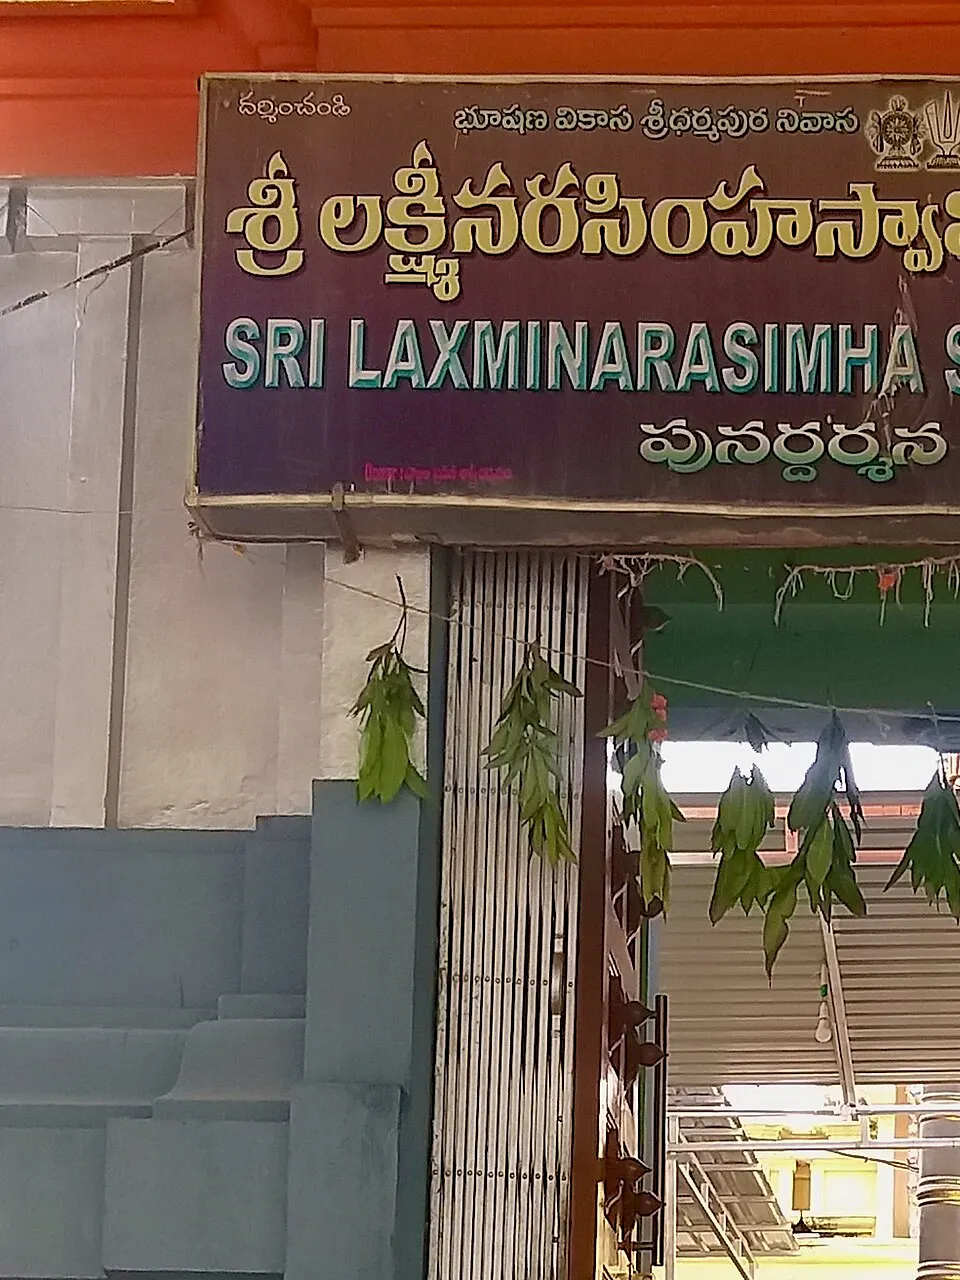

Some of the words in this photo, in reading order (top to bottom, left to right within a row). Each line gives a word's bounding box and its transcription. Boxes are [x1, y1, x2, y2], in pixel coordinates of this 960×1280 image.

[238, 91, 350, 123] దర్శించండి
[454, 104, 549, 133] భూషణ
[554, 105, 632, 131] వికాస
[776, 107, 858, 133] నివాస
[225, 150, 304, 277] శ్రీ
[221, 317, 326, 388] SRI
[348, 319, 925, 395] LAXMINARASIMHA
[639, 419, 947, 482] పునర్దర్శన
